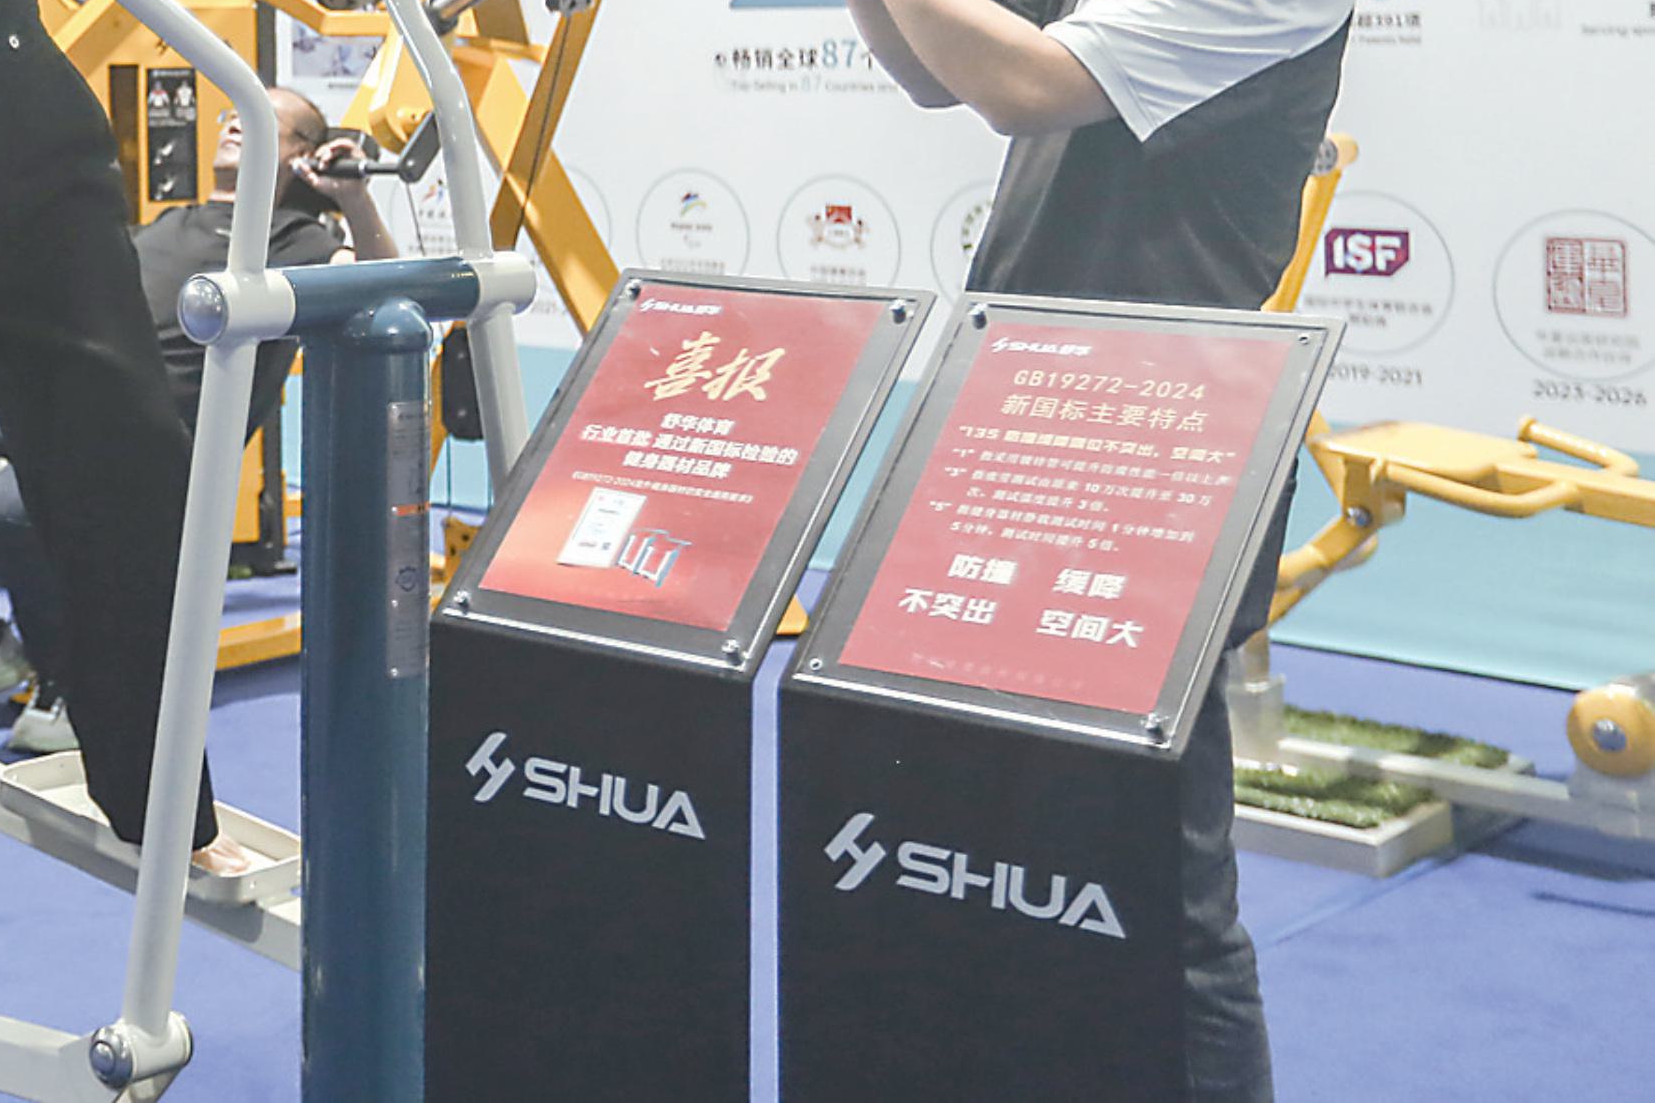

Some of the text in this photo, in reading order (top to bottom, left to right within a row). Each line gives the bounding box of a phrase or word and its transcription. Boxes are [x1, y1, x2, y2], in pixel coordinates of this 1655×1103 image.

[1333, 233, 1403, 273] ISF
[644, 330, 786, 402] 喜报
[1013, 369, 1207, 400] GB19272-2024
[1000, 394, 1209, 433] 新国标主要特点
[947, 553, 1127, 600] 防撞 缓降
[898, 588, 1145, 648] 不突出 空间大
[523, 756, 706, 840] SHUA
[896, 840, 1126, 939] SHUA
